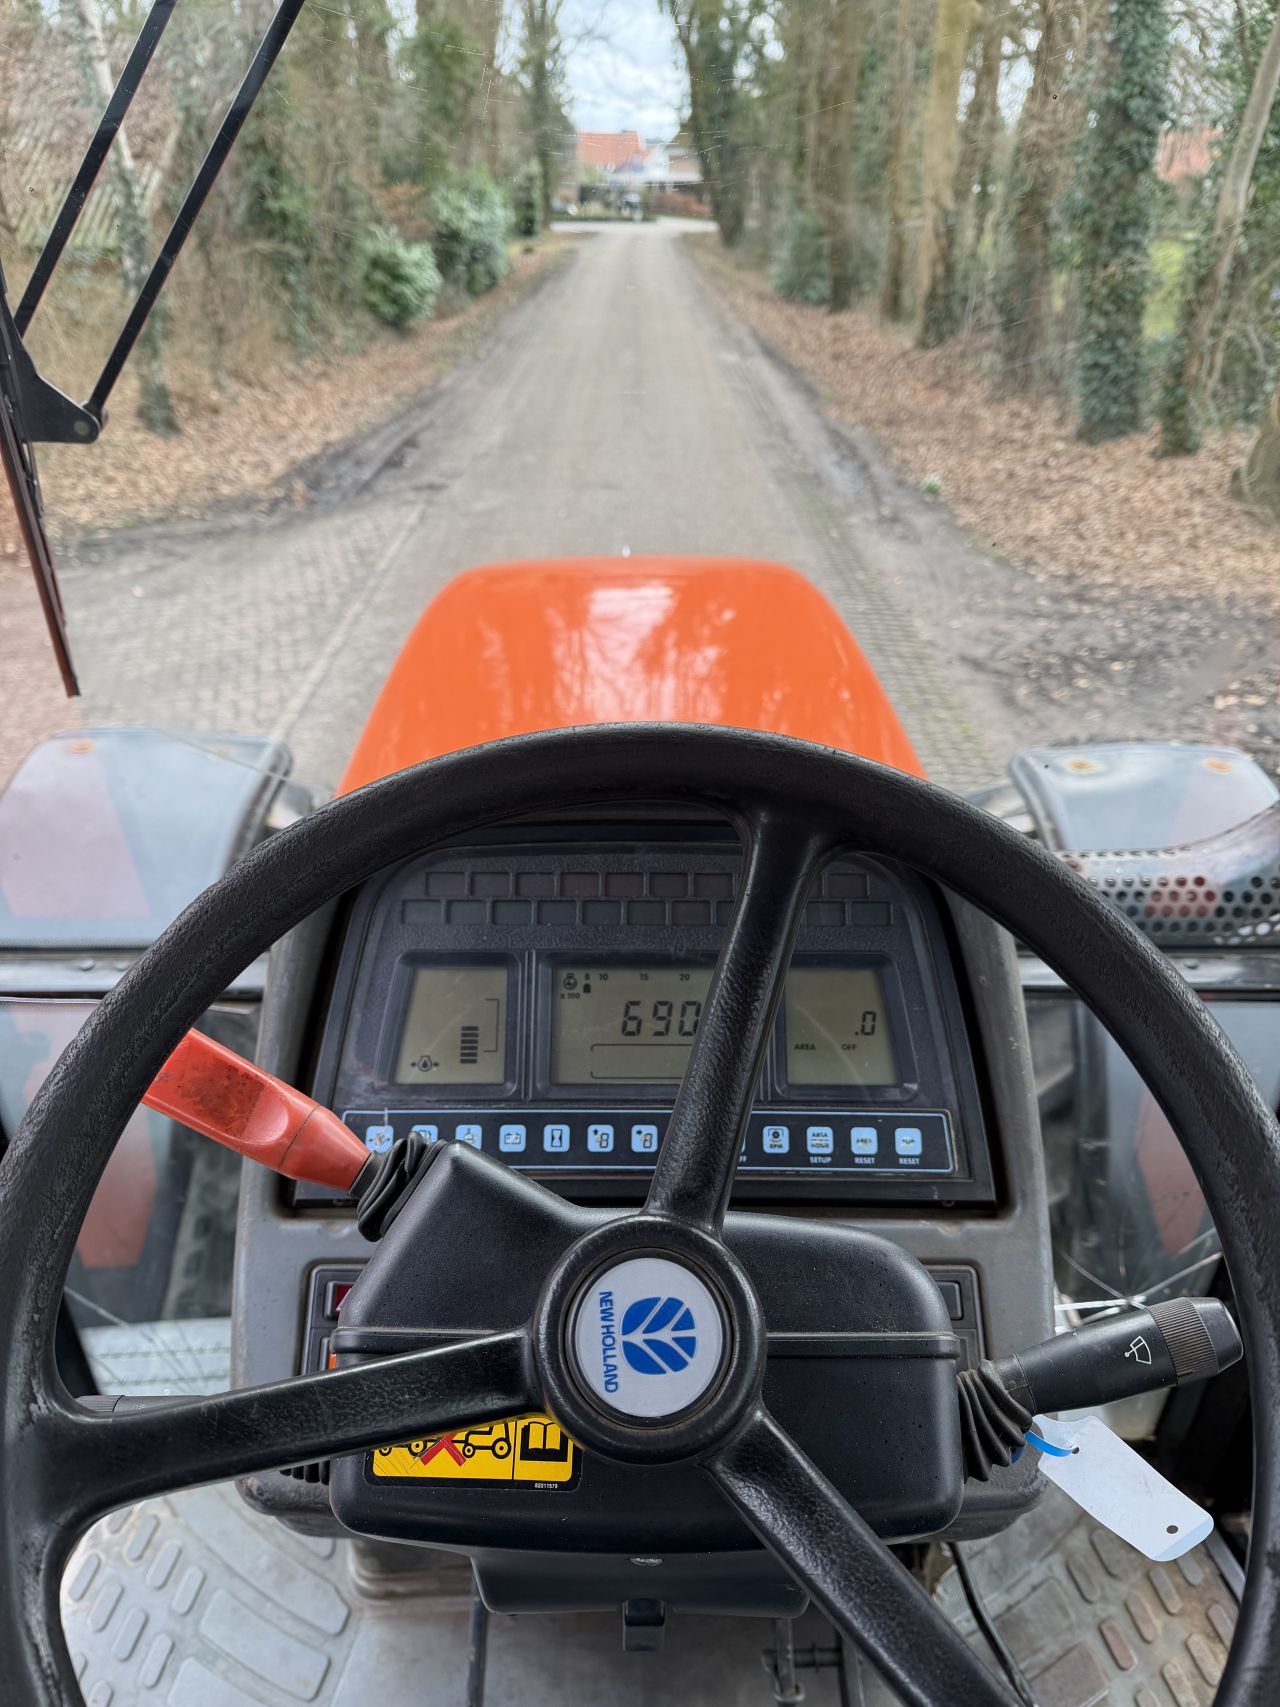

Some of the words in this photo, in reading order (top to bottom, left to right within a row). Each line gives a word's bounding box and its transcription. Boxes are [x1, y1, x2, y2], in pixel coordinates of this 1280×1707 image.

[599, 973, 608, 981] 10
[640, 973, 649, 981] 15
[679, 973, 690, 981] 20
[621, 1000, 702, 1036] 690
[599, 1291, 614, 1322] NEW
[601, 1324, 618, 1393] HOLLAND
